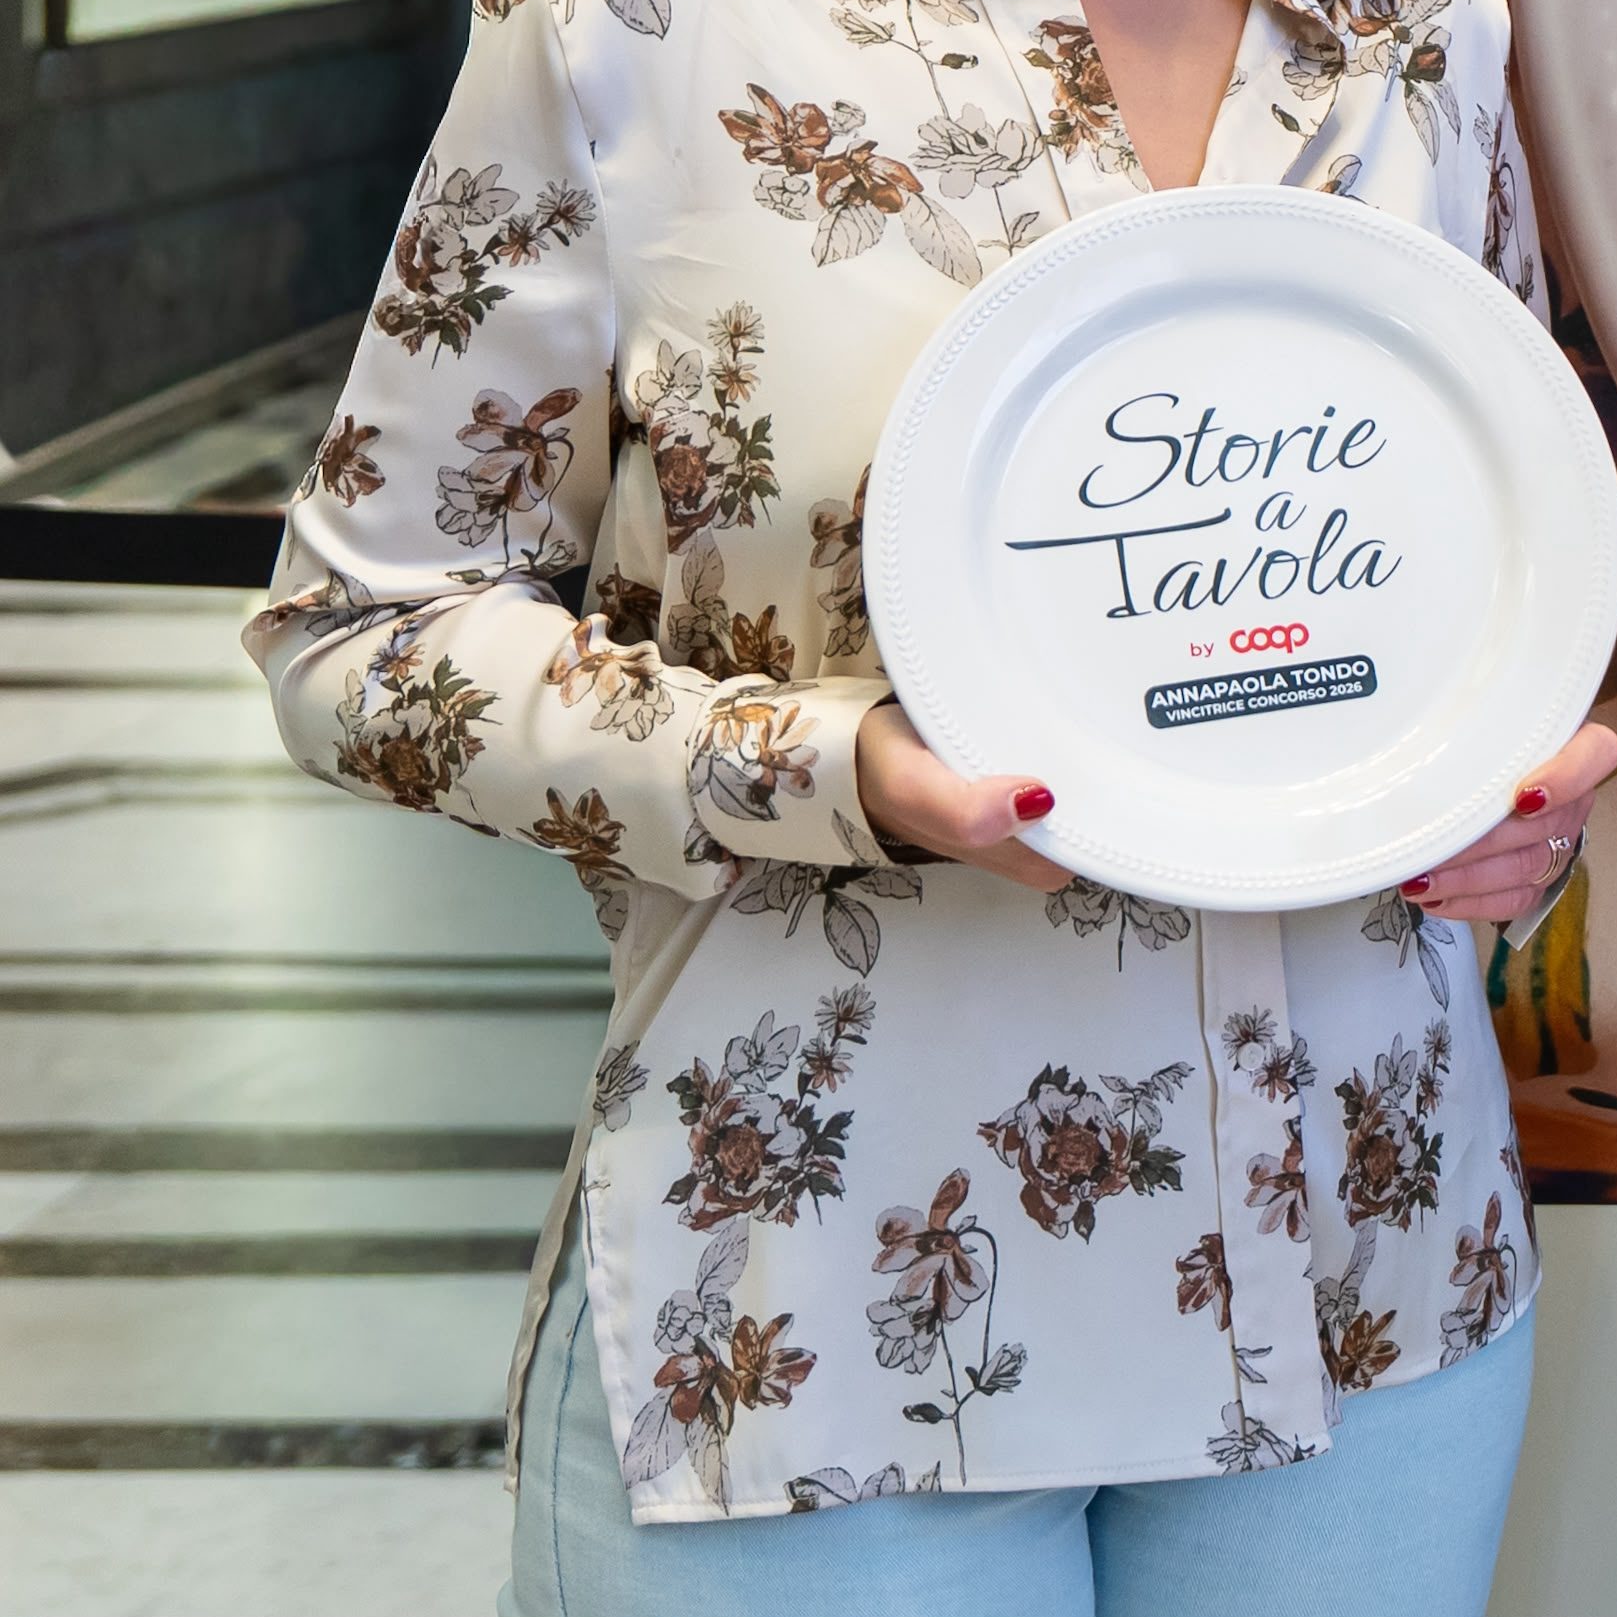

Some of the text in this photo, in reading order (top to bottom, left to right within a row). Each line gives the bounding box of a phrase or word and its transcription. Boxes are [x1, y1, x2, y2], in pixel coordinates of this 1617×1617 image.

[1078, 393, 1387, 509] Storie
[1255, 491, 1307, 532] a
[1004, 507, 1403, 619] Tavola
[1190, 622, 1309, 658] by coop
[1151, 660, 1369, 708] ANNAPAOLA TONDO
[1166, 681, 1363, 722] VINCITRICE CONCORSO 2026
